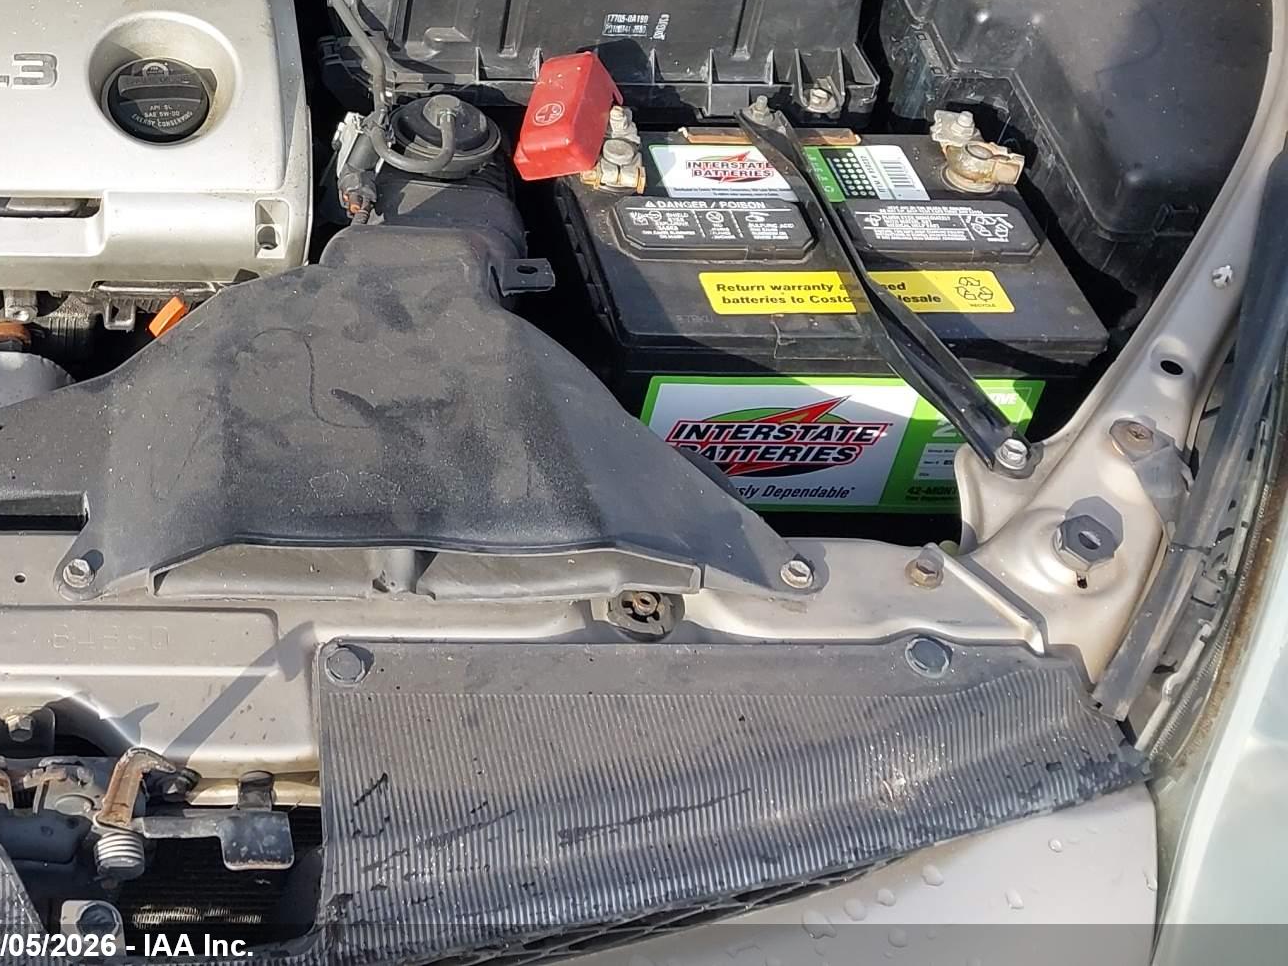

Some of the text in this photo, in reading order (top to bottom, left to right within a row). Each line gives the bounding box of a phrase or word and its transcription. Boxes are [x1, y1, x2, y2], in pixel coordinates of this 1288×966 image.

[686, 161, 774, 169] INTERSTATE
[693, 169, 772, 177] BATTERIES
[656, 201, 707, 209] DANGER
[718, 201, 766, 209] POISON
[716, 283, 765, 292] Return
[769, 283, 834, 294] warranty
[880, 282, 906, 291] sed
[722, 294, 942, 304] batteries to Costc lesale
[672, 423, 881, 443] INTERSTATE
[762, 485, 850, 500] Dependable
